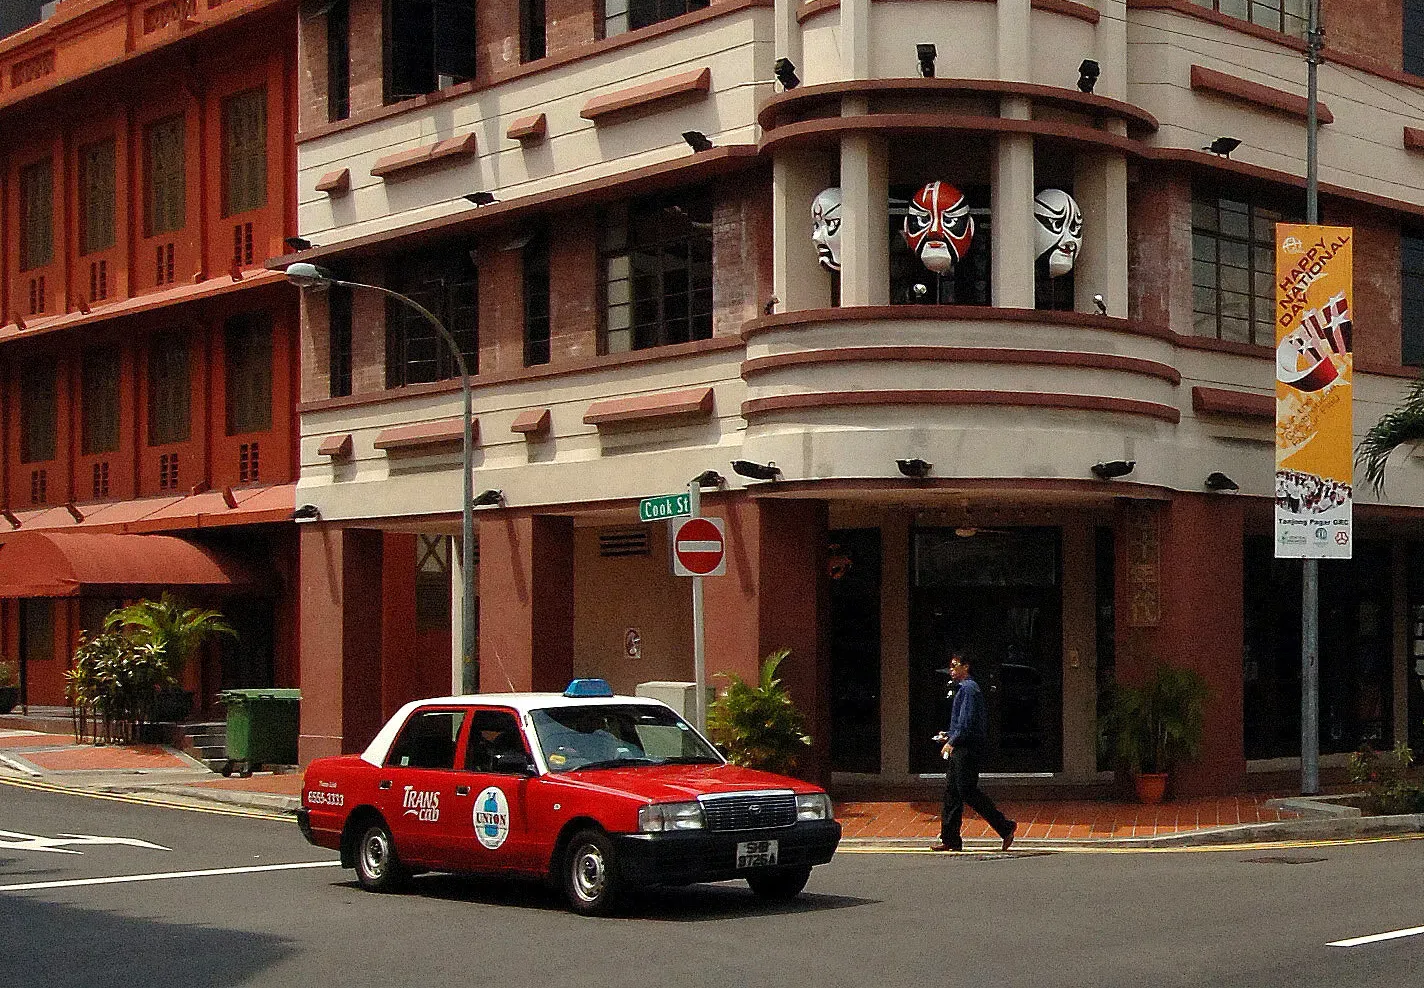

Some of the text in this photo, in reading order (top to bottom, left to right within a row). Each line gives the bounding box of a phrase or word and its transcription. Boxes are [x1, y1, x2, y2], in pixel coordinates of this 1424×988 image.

[1278, 235, 1351, 310] NATIONAL
[1279, 236, 1327, 292] HAPPY
[1278, 291, 1309, 328] DAY
[645, 496, 689, 517] Cook St
[1278, 518, 1308, 526] Tanjong
[475, 812, 507, 826] UNION
